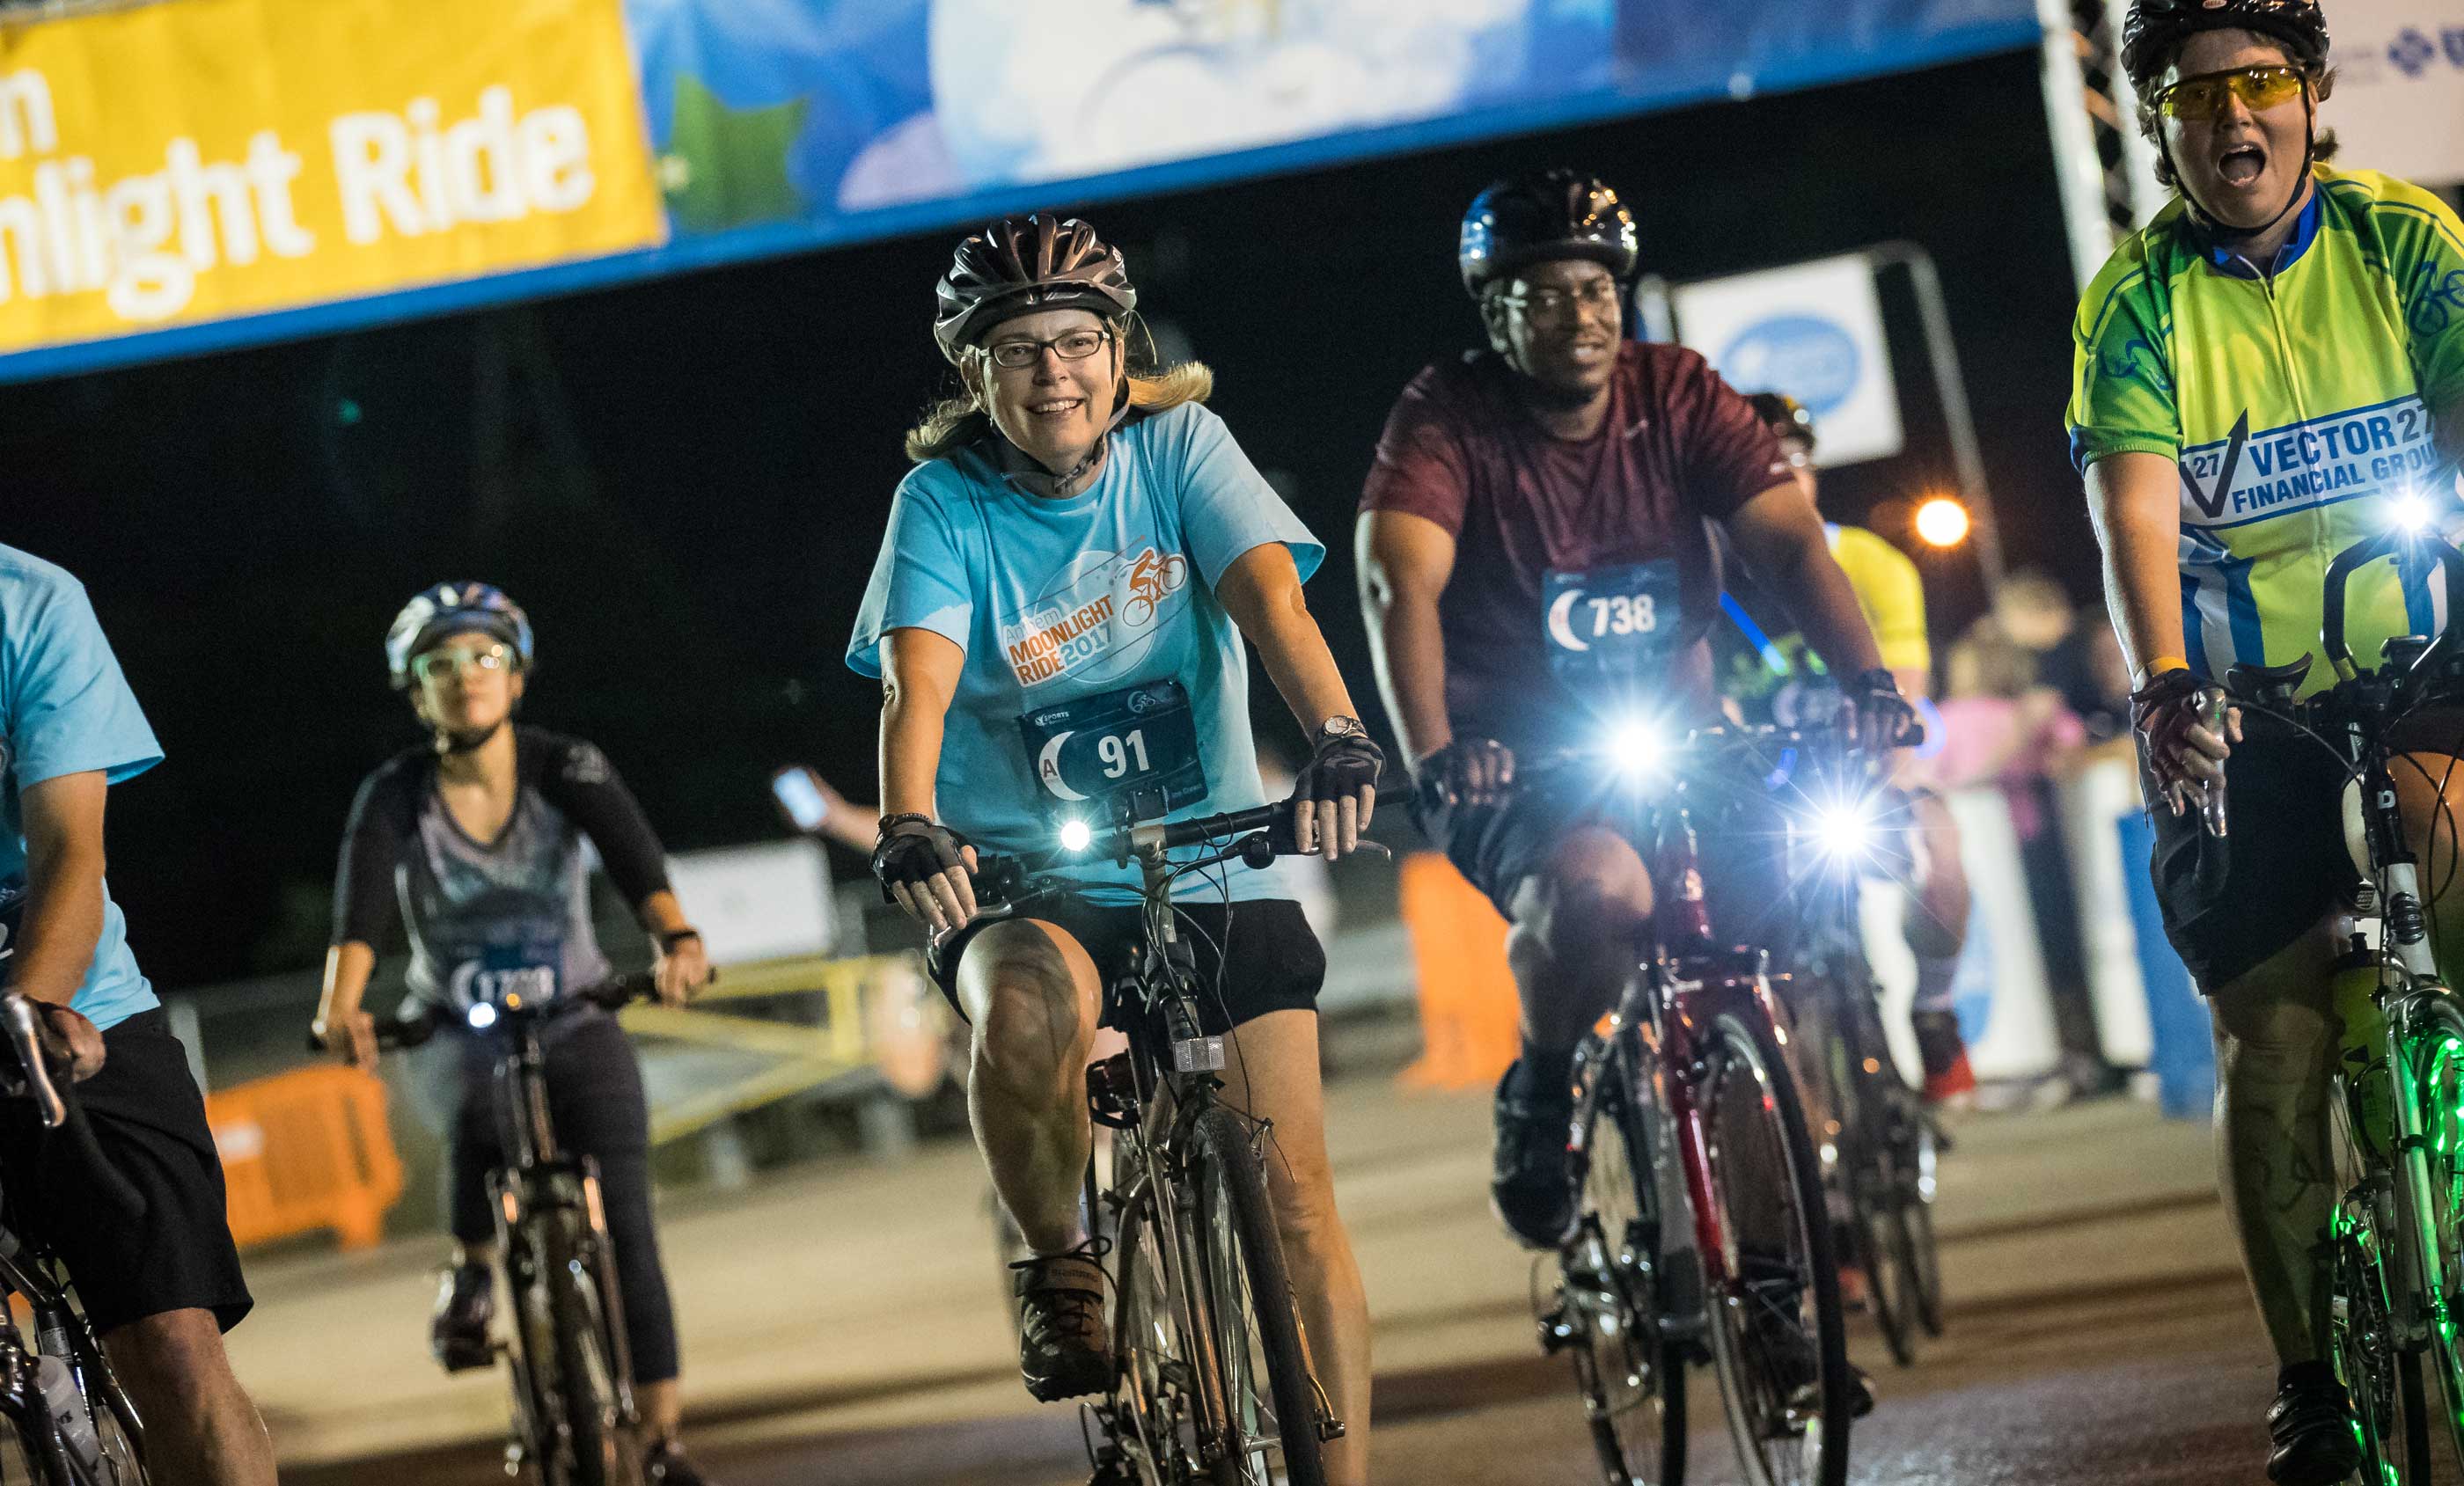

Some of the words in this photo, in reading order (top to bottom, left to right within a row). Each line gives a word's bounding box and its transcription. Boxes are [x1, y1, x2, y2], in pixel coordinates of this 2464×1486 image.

[329, 84, 596, 245] Ride
[2193, 453, 2220, 479] 27
[2248, 415, 2397, 478] VECTOR
[2232, 463, 2366, 514] FINANCIAL
[1008, 594, 1114, 666] MOONLIGHT
[1588, 593, 1657, 637] 738
[1016, 650, 1065, 684] RIDE
[1060, 621, 1112, 666] 2017
[1042, 758, 1058, 779] A
[1098, 729, 1150, 779] 91
